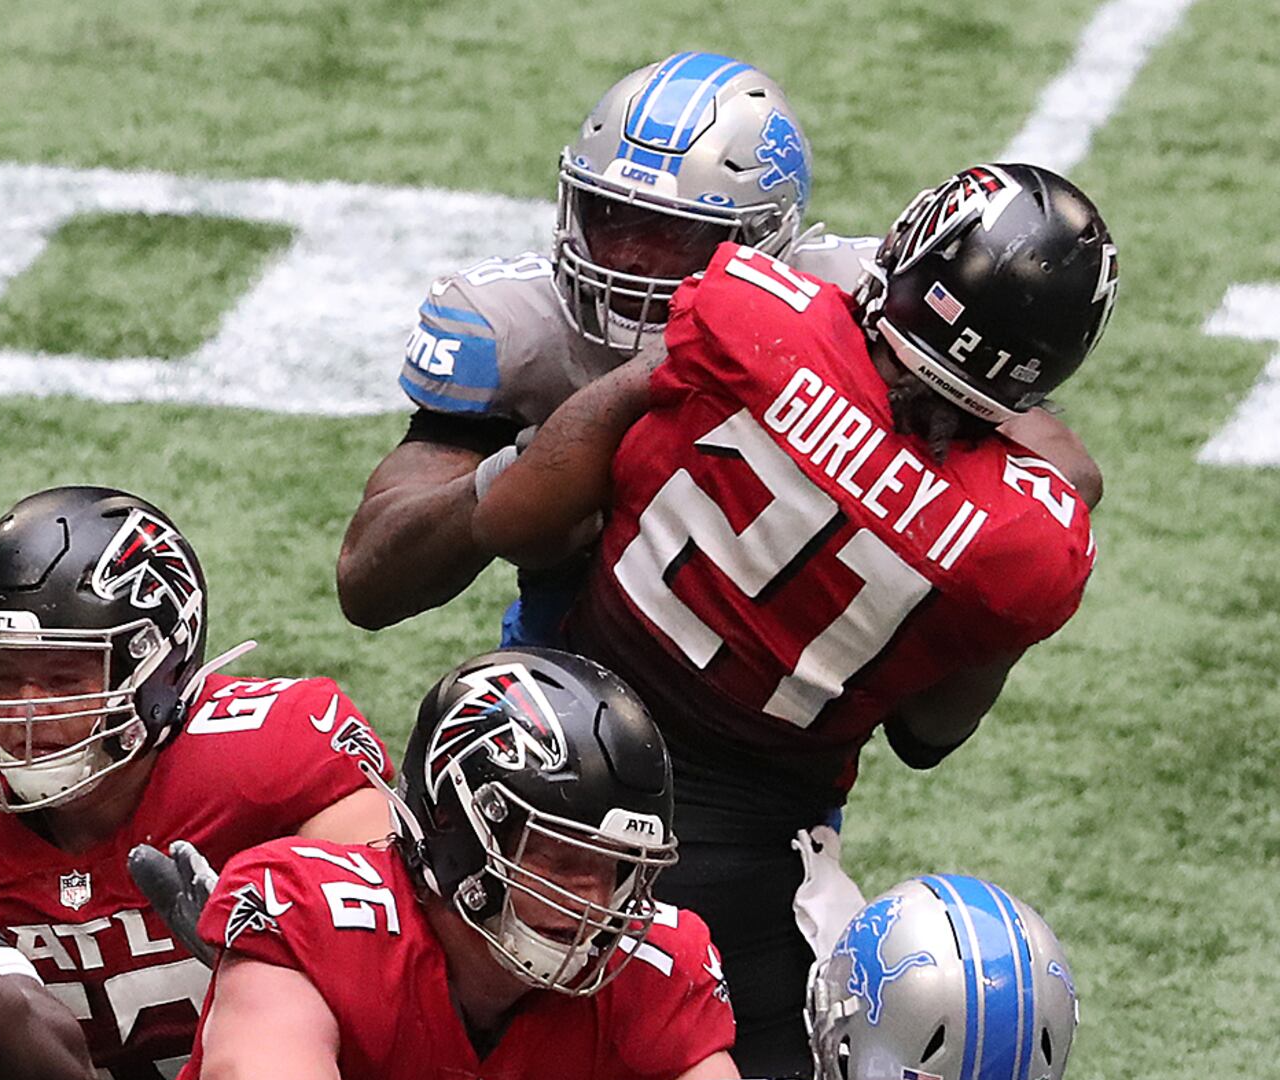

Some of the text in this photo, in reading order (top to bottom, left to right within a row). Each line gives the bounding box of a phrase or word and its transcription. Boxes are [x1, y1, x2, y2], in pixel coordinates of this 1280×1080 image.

[763, 366, 988, 571] GURLEY II
[613, 406, 933, 730] 21
[625, 818, 655, 836] ATL
[290, 846, 401, 936] 76
[6, 908, 175, 971] ATL
